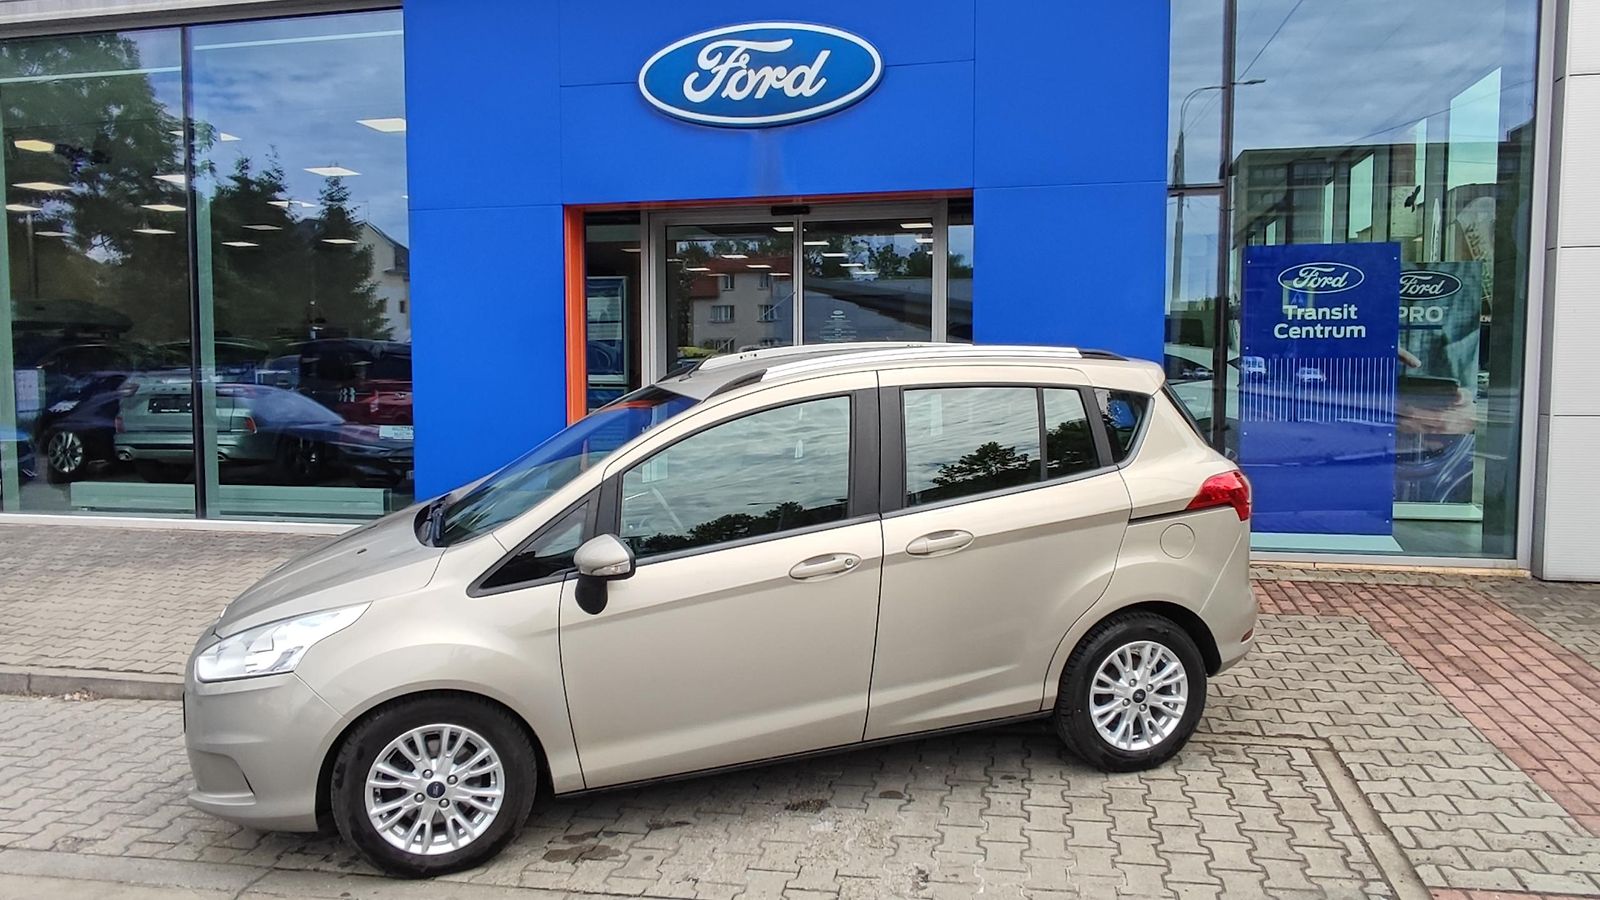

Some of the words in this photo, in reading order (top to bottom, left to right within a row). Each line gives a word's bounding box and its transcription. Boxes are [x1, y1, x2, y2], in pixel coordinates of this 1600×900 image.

[683, 38, 831, 103] Ford
[1292, 266, 1349, 288] Ford
[1399, 274, 1446, 295] Ford
[1282, 303, 1358, 320] Transit
[1273, 323, 1367, 339] Centrum
